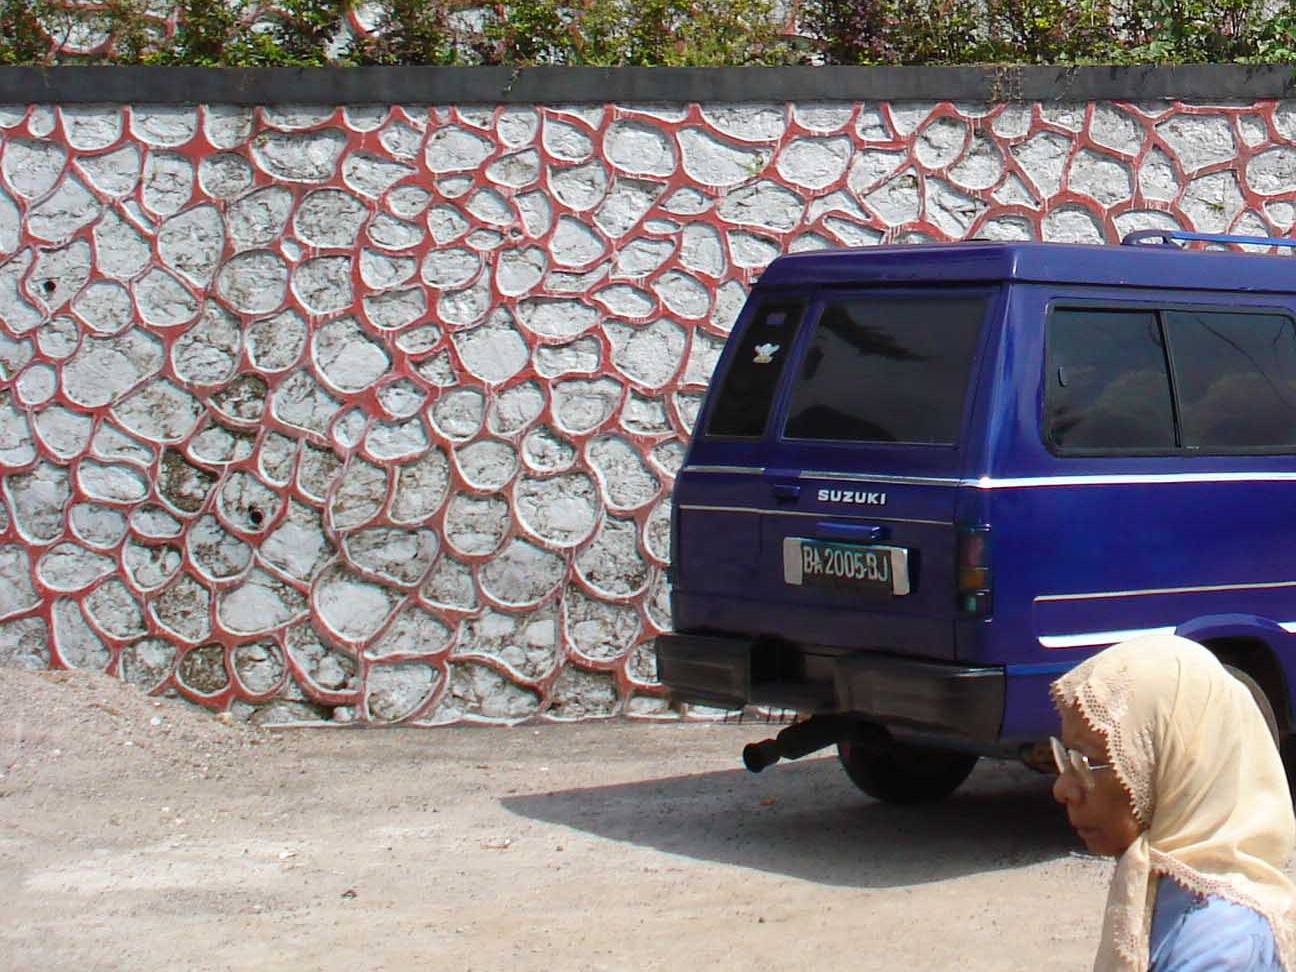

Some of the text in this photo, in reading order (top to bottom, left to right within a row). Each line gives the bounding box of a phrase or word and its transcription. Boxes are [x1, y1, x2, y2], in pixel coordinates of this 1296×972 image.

[817, 489, 886, 505] SUZUKI
[803, 546, 823, 574] BA
[825, 549, 865, 579] 2005
